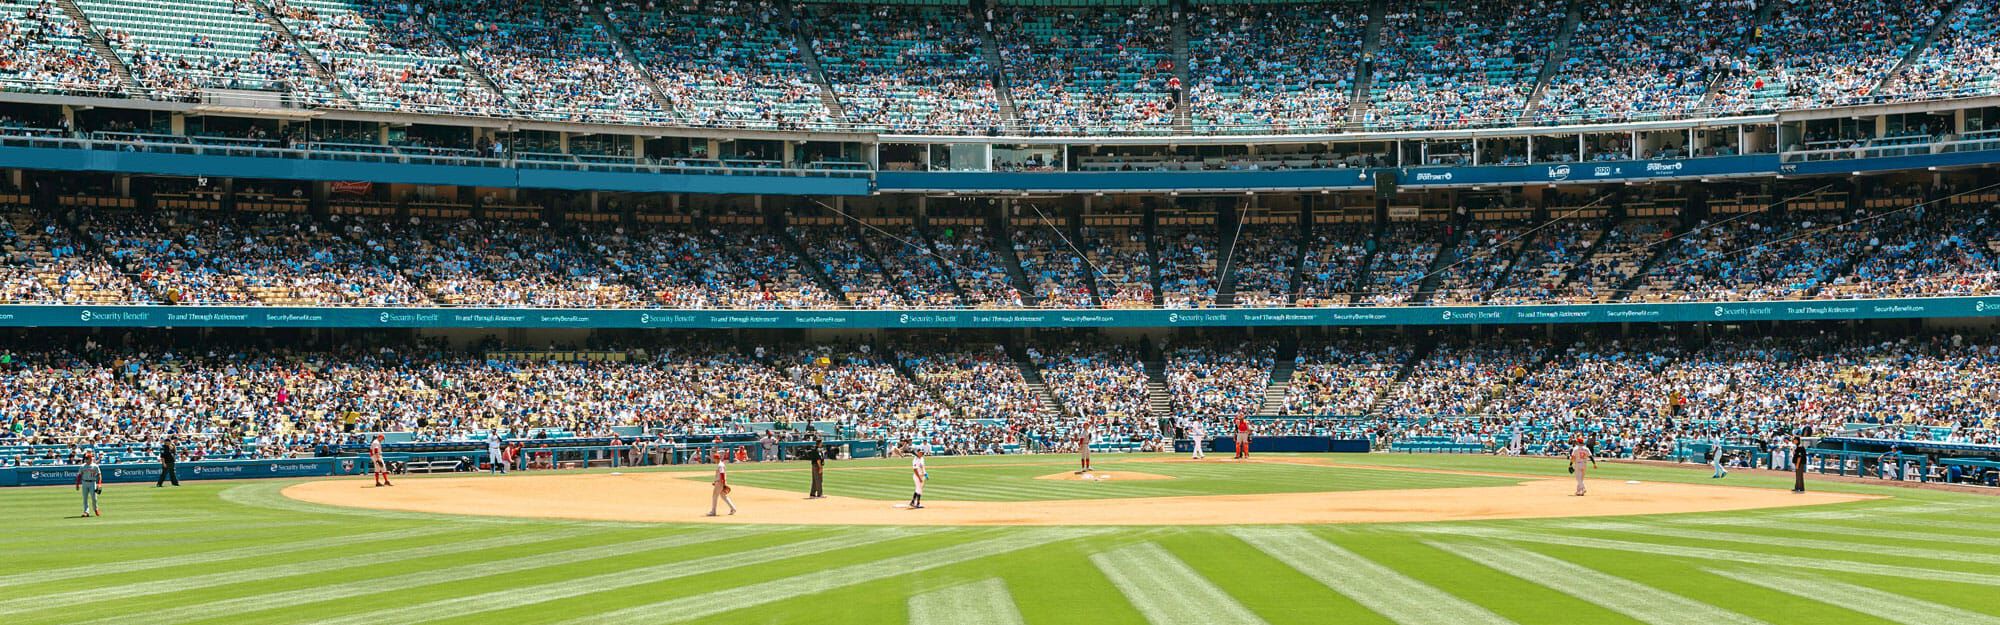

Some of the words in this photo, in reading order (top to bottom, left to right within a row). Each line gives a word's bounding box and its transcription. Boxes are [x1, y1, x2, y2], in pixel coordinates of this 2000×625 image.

[92, 312, 121, 322] Security
[123, 312, 148, 320] Benefit
[389, 313, 415, 322] Security
[416, 313, 438, 321] Benefit
[650, 315, 673, 323] Security
[909, 315, 934, 323] Security
[40, 471, 63, 479] Security
[122, 469, 144, 477] Security
[145, 468, 163, 476] Benefi
